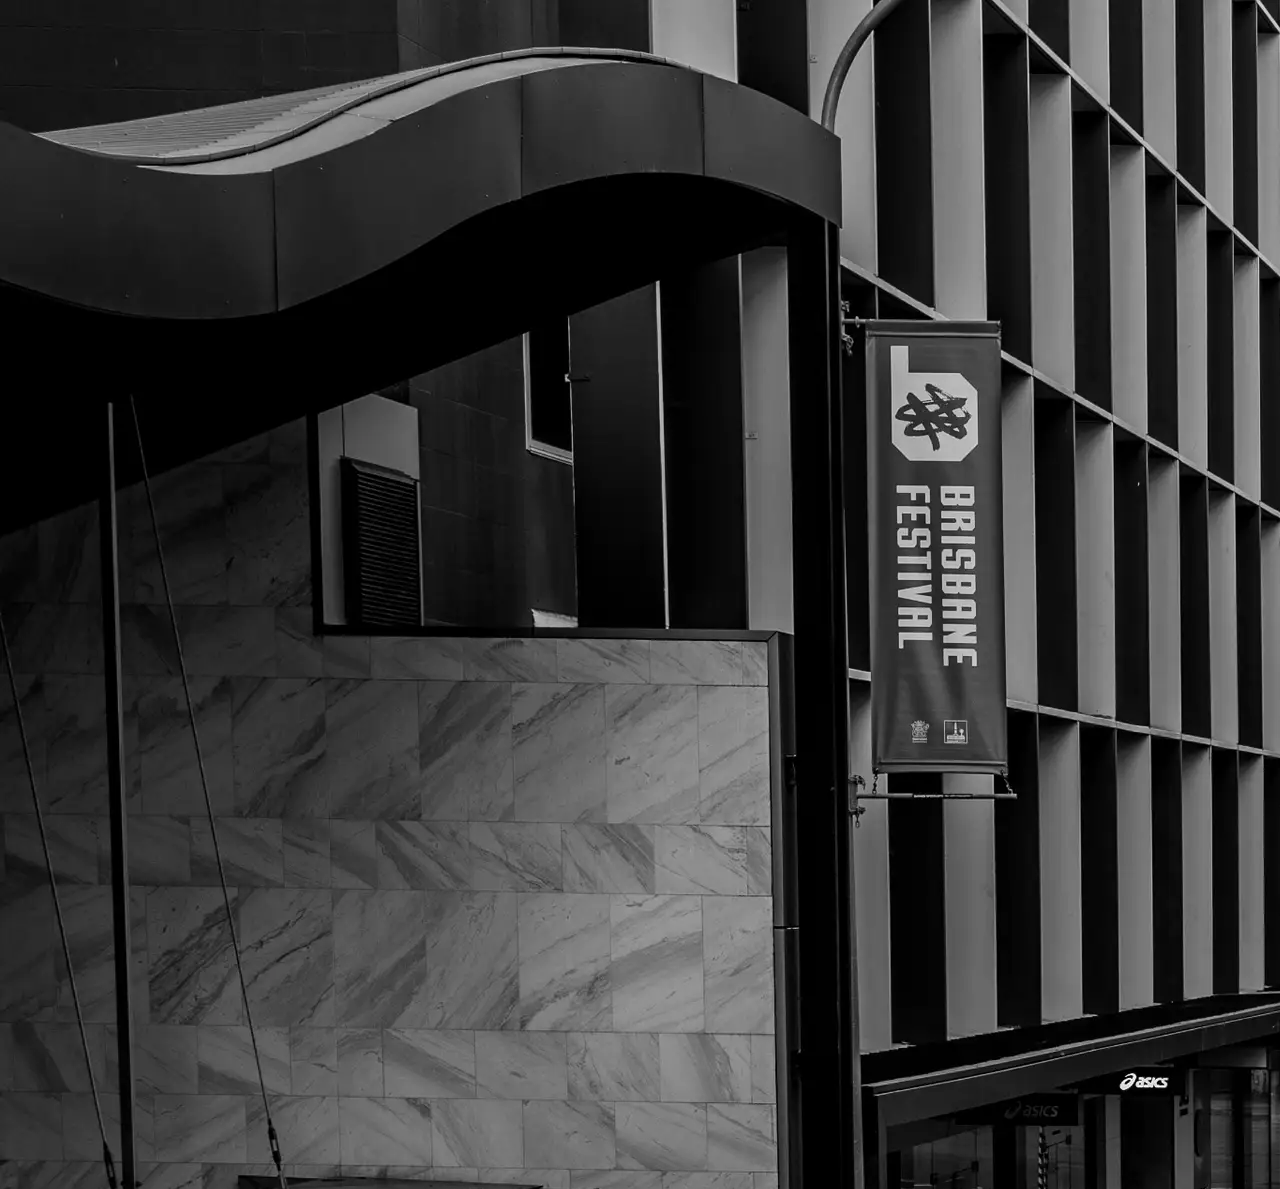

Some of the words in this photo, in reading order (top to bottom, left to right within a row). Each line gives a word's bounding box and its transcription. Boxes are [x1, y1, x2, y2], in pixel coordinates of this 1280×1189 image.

[896, 484, 933, 650] FESTIVAL
[940, 485, 978, 667] BRISBANE
[1022, 1104, 1060, 1118] asics
[1135, 1076, 1169, 1089] asics
